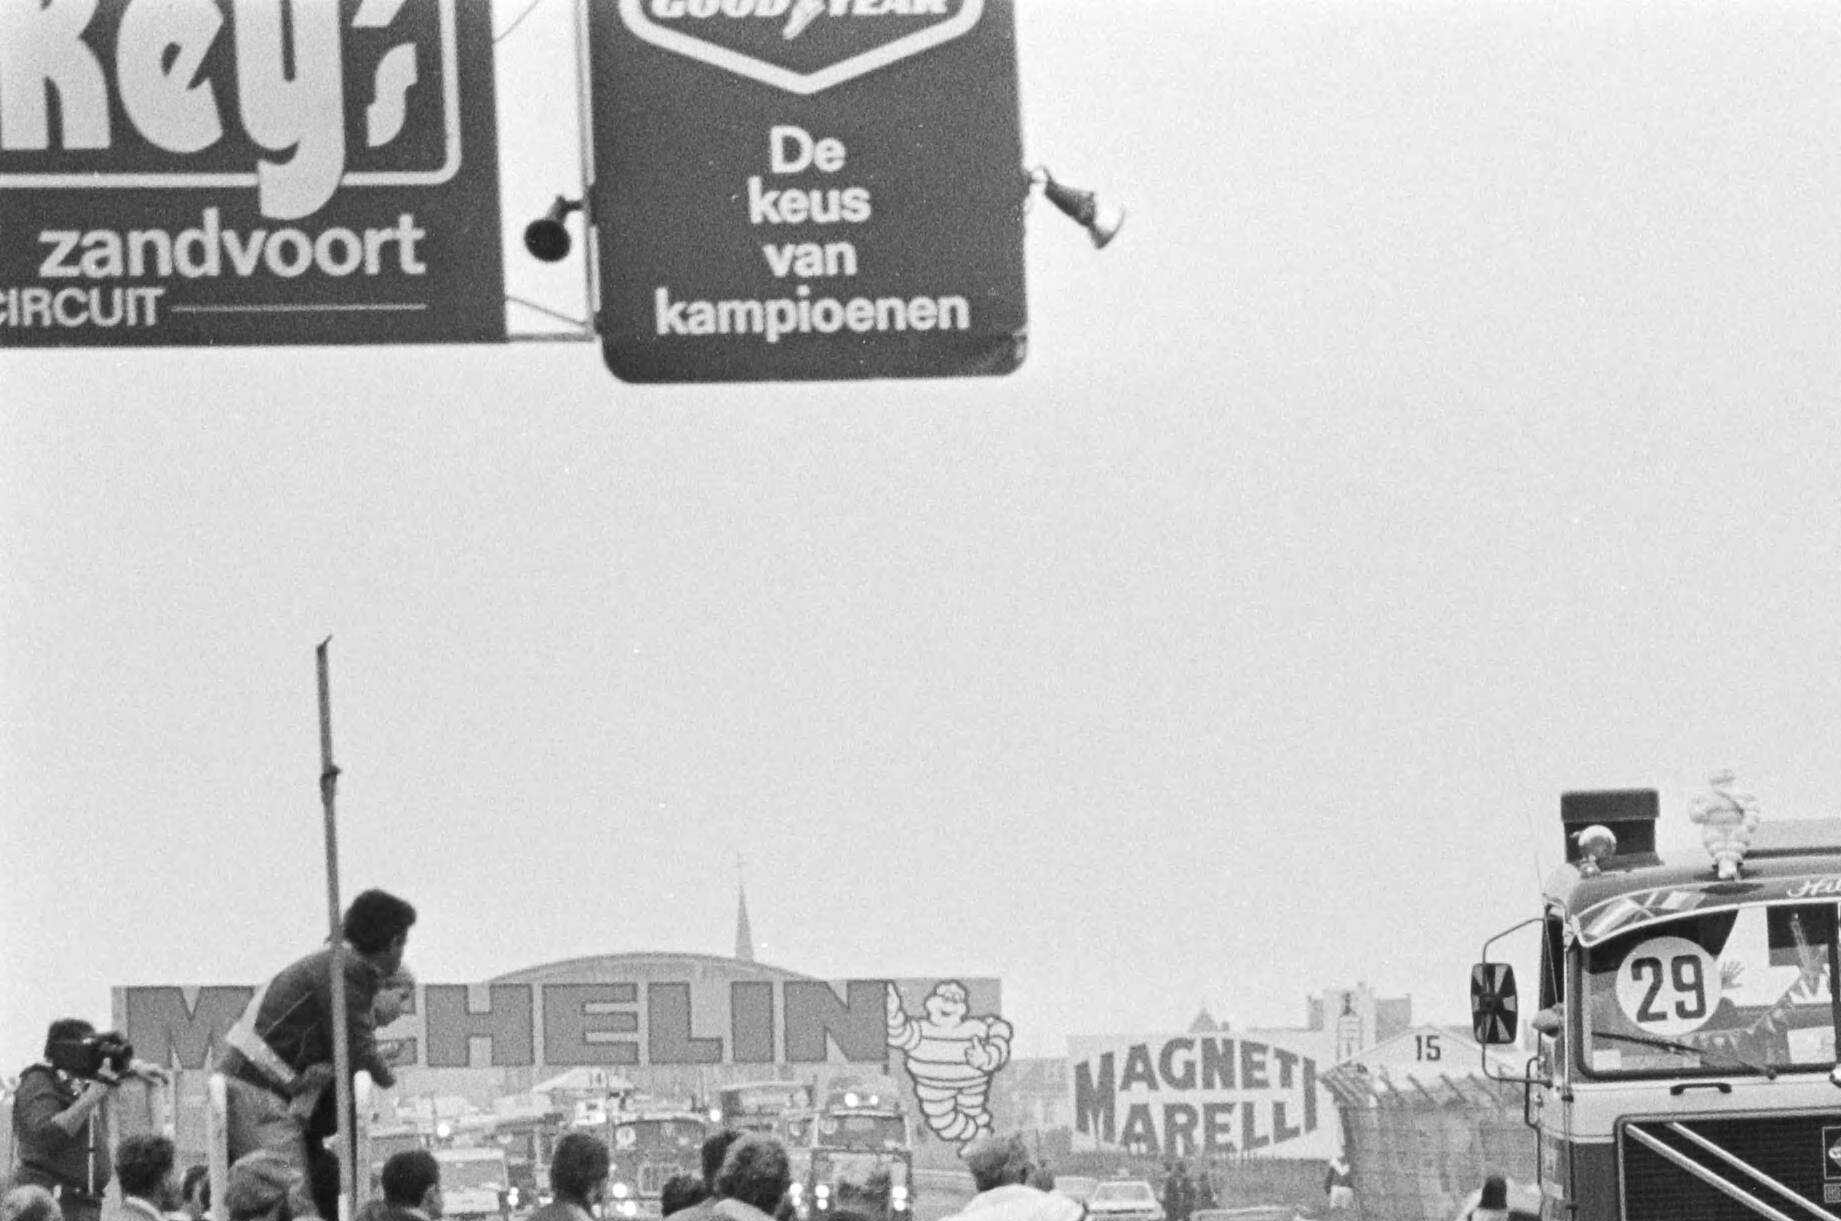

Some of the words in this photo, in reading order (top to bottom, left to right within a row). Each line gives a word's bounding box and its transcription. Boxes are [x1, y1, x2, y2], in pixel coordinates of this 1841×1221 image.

[770, 125, 846, 174] De
[748, 175, 871, 224] keus
[38, 206, 427, 279] zandvoort
[763, 242, 857, 277] van
[655, 287, 970, 343] kampioenen
[1631, 954, 1707, 1022] 29
[127, 980, 888, 1069] MHELIN
[1415, 1035, 1441, 1062] 15
